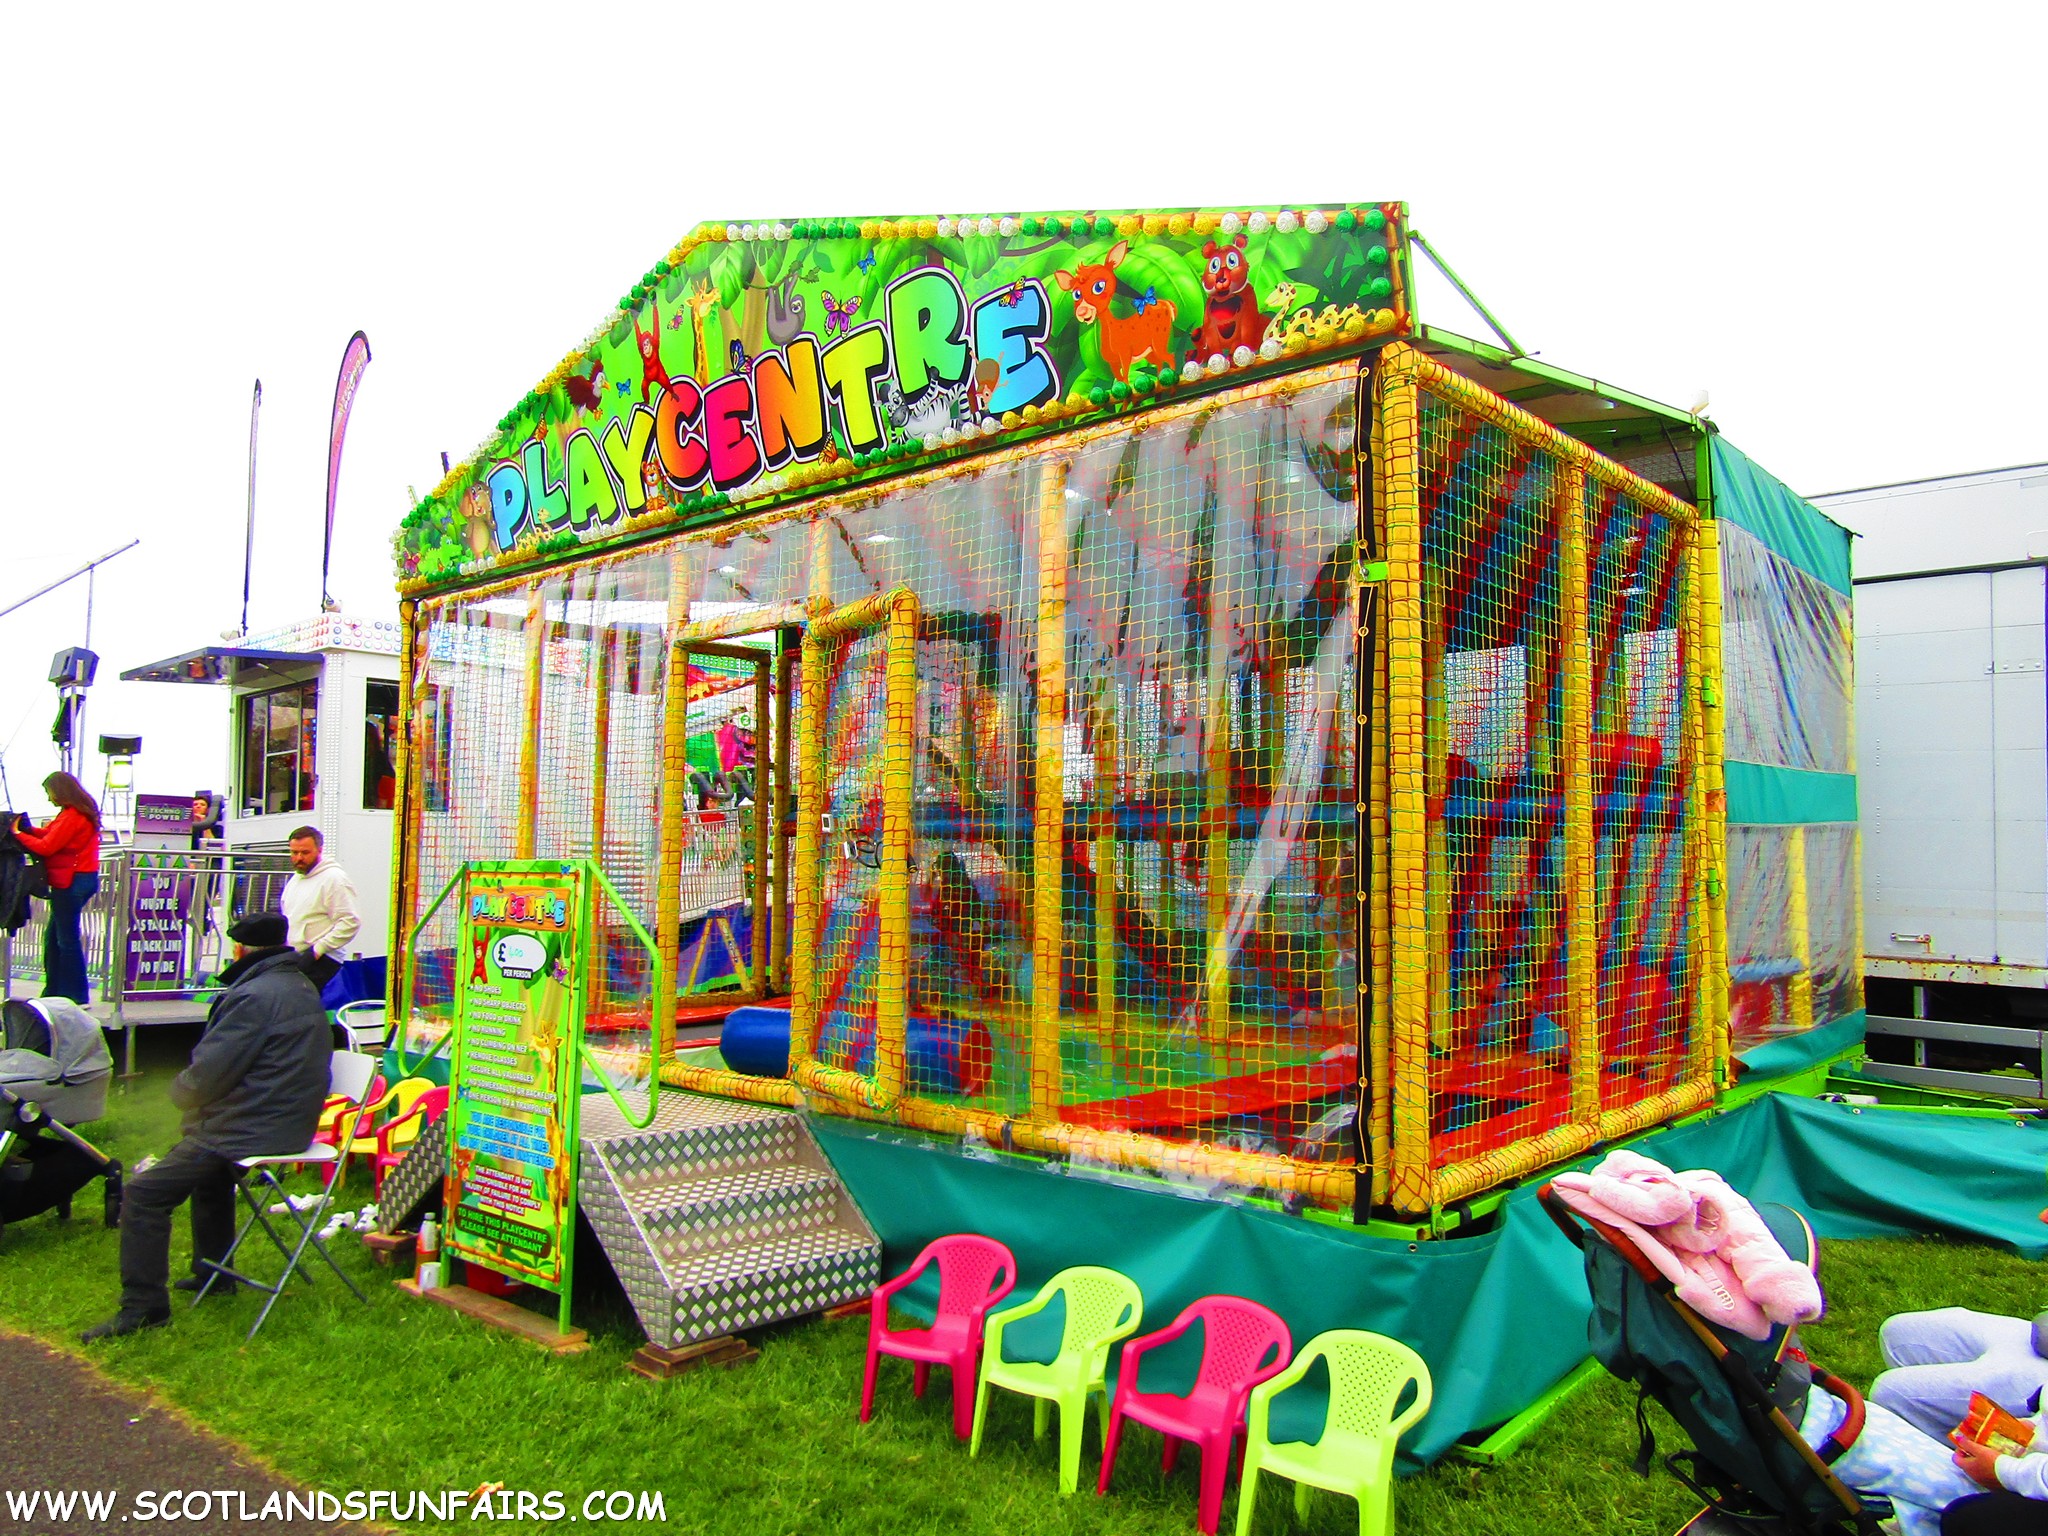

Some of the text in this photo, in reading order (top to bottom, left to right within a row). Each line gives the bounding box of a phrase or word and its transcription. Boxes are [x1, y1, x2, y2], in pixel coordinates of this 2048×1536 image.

[485, 266, 1059, 552] PLAYCENTRE
[152, 877, 171, 889] YOU
[140, 898, 179, 910] MUST BE
[472, 890, 566, 927] PLAYCENTRE
[147, 919, 169, 931] TALL
[170, 919, 183, 931] AS
[131, 940, 162, 952] BLACK
[140, 961, 151, 973] TO
[503, 968, 532, 979] PER PERSON
[473, 985, 502, 995] NO SHOES
[472, 998, 527, 1012] NO SHARP OBJECTS
[471, 1012, 481, 1020] NO
[482, 1012, 497, 1022] FOOD
[503, 1015, 522, 1025] DRINK
[470, 1025, 506, 1036] NO RUNNING
[469, 1038, 480, 1046] NO
[480, 1039, 506, 1051] CLIMBING
[506, 1042, 515, 1052] ON
[469, 1051, 517, 1067] REMOVE GLASSES
[469, 1064, 534, 1084] SECURE ALL VALUABLES
[478, 1080, 516, 1095] SOMERSAULTS
[525, 1089, 557, 1102] BACKFLIPS
[467, 1092, 480, 1101] ONE
[480, 1093, 502, 1106] PERSON
[515, 1100, 553, 1116] TRAMPOLINE
[494, 1115, 534, 1136] RESPONSIBLE
[534, 1124, 547, 1138] FOR
[531, 1138, 551, 1154] TIMES
[515, 1149, 555, 1170] UNATTENDED
[475, 1166, 486, 1175] THE
[486, 1168, 515, 1181] ATTENDANT
[521, 1178, 533, 1187] NOT
[475, 1175, 531, 1196] RESPONSIBLE FOR ANY
[464, 1181, 483, 1192] INJURY
[490, 1188, 512, 1201] FAILURE
[512, 1195, 520, 1203] TO
[519, 1197, 541, 1209] COMPLY
[480, 1196, 525, 1214] WITH THIS NOTICE
[458, 1207, 548, 1243] TO HIRE THIS PLAYCENTRE
[460, 1219, 543, 1253] PLEASE SEE ATTENDANT
